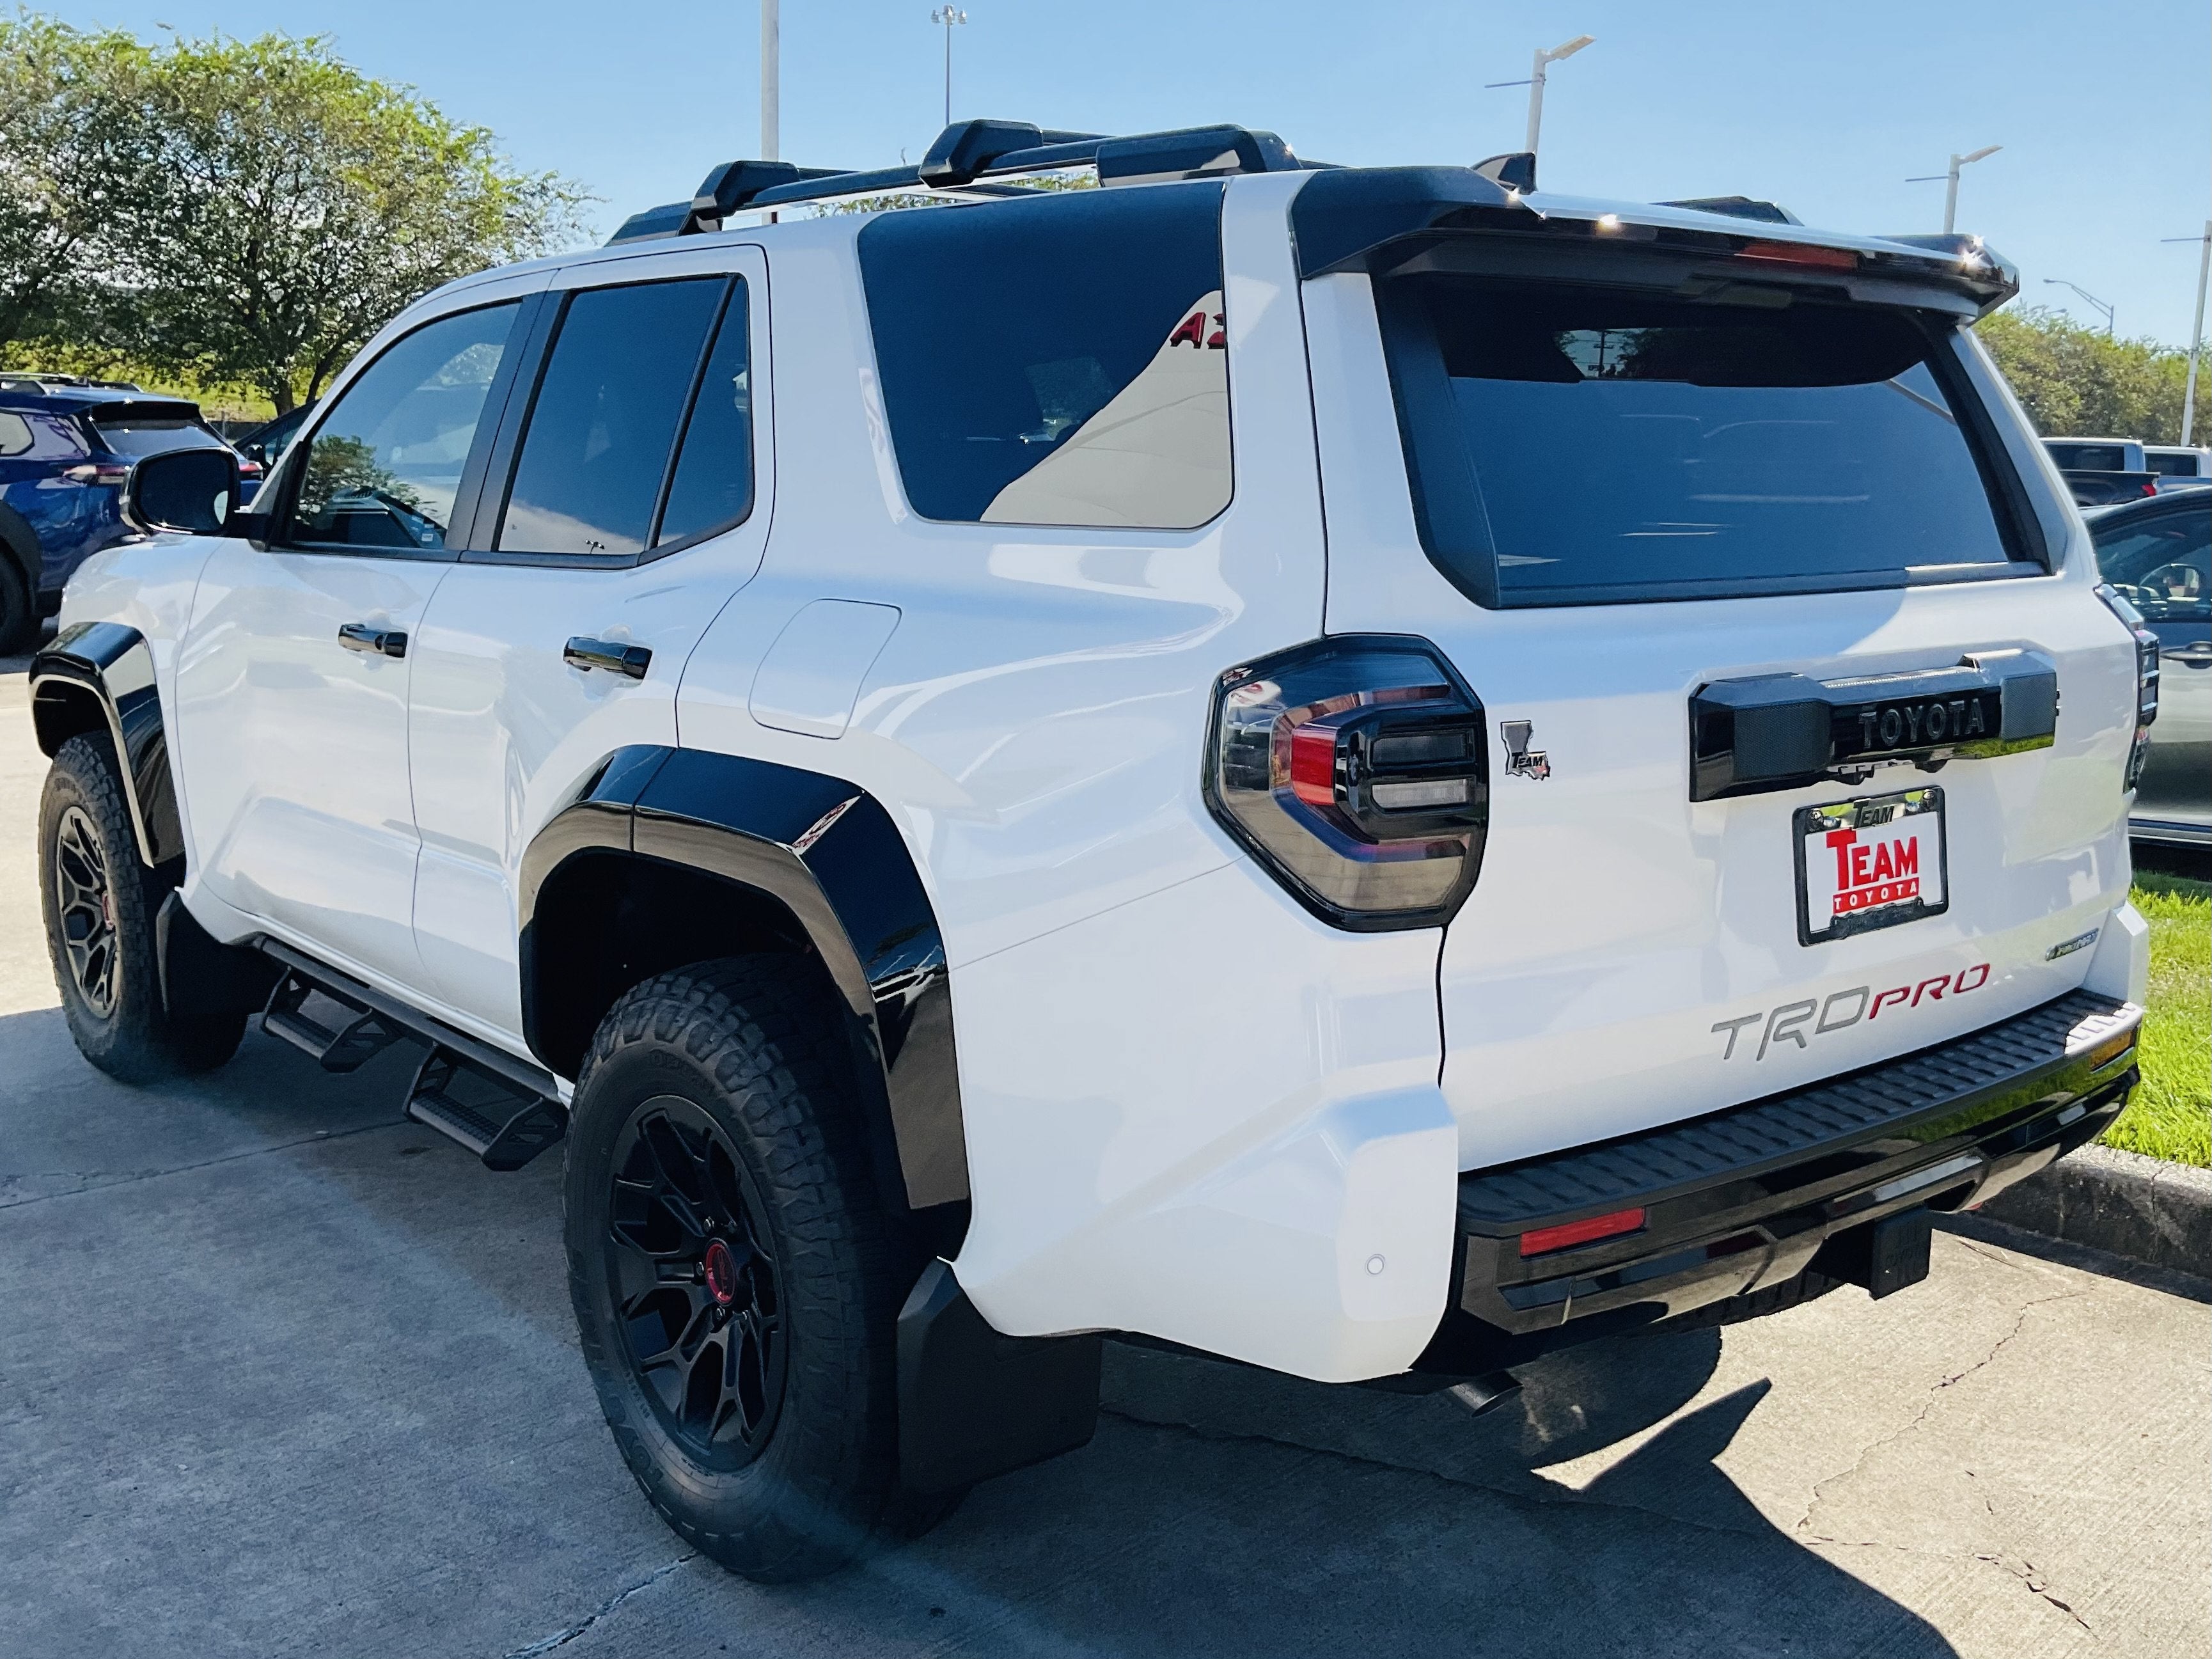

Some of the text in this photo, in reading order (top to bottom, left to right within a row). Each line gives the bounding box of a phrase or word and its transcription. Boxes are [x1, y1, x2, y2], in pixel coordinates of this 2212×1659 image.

[1858, 698, 1984, 748] TOYOTA
[1511, 751, 1543, 768] TEAM
[1853, 800, 1895, 829] TEAM
[1826, 828, 1918, 891] TEAM
[1834, 881, 1917, 910] TOYOTA
[1711, 963, 1990, 1062] TRD PRO
